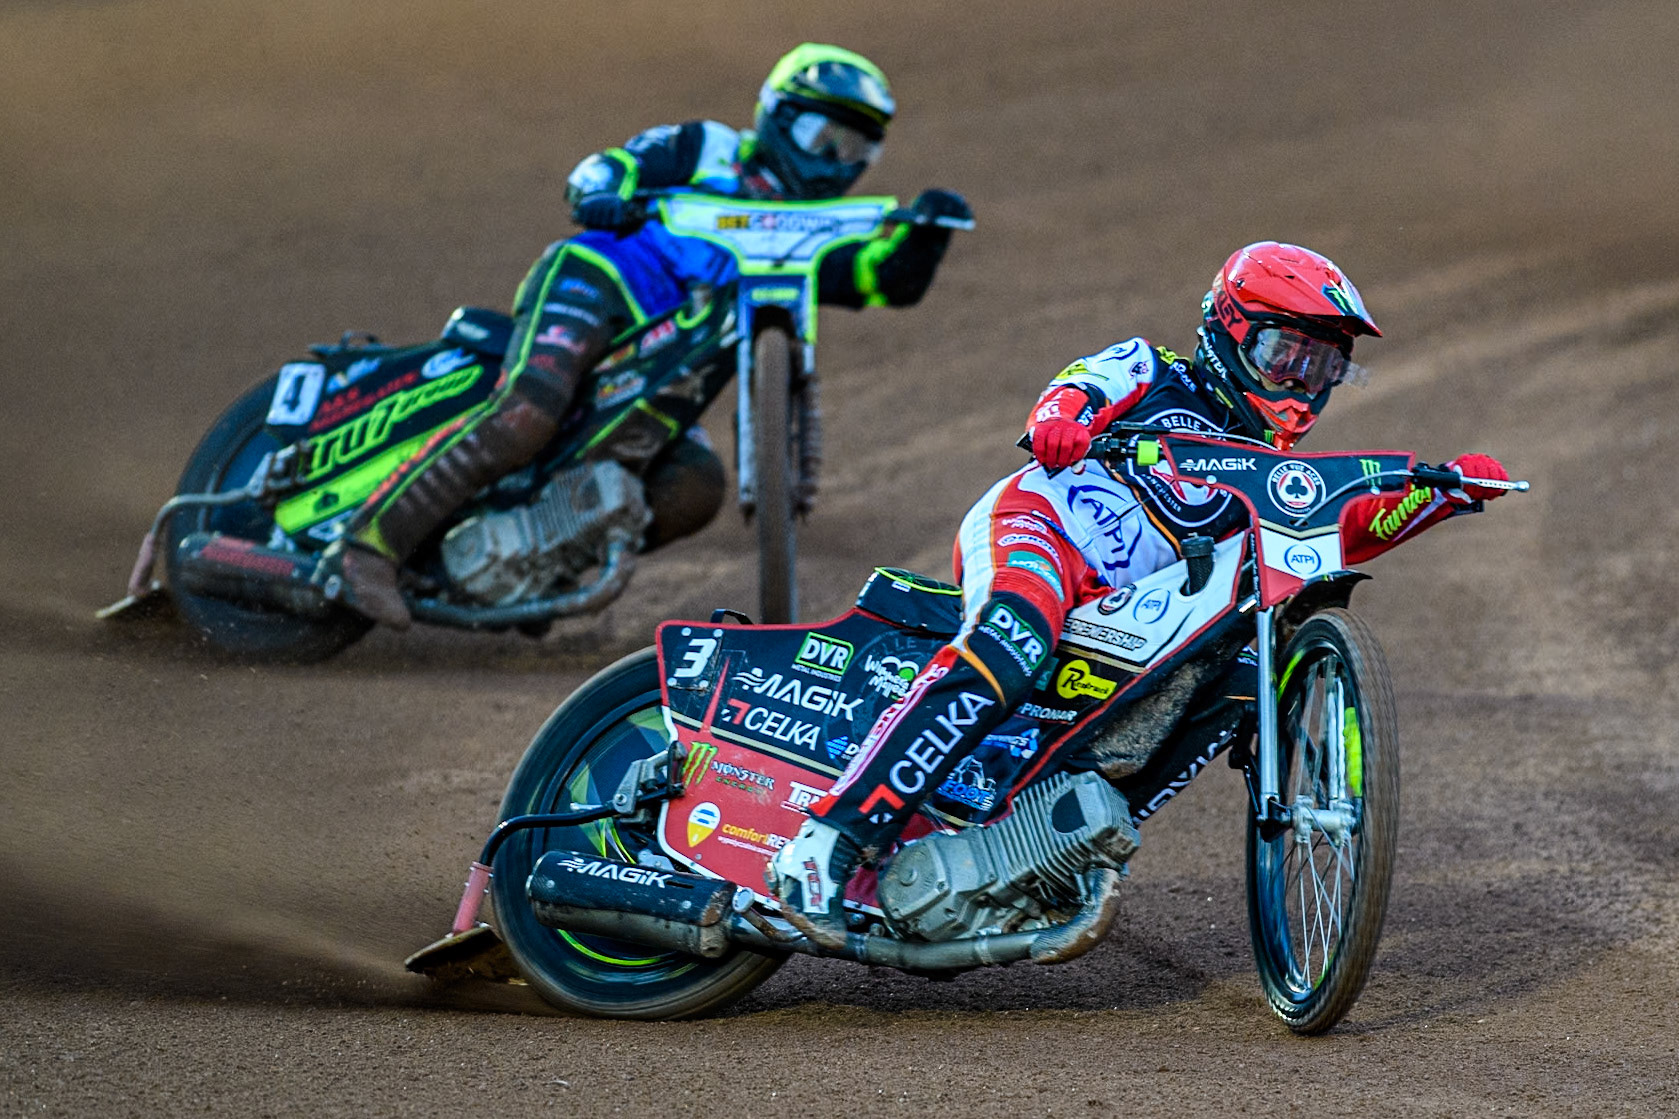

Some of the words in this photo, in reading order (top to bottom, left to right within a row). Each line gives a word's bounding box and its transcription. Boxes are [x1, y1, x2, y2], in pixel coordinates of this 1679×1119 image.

[1160, 414, 1202, 432] BELLE
[1290, 554, 1315, 565] ATPI
[988, 603, 1044, 664] DVR
[673, 637, 717, 678] 3
[801, 638, 849, 670] DVR
[743, 706, 822, 751] CELKA
[889, 691, 996, 795] CELKA
[711, 760, 776, 791] MONSTER
